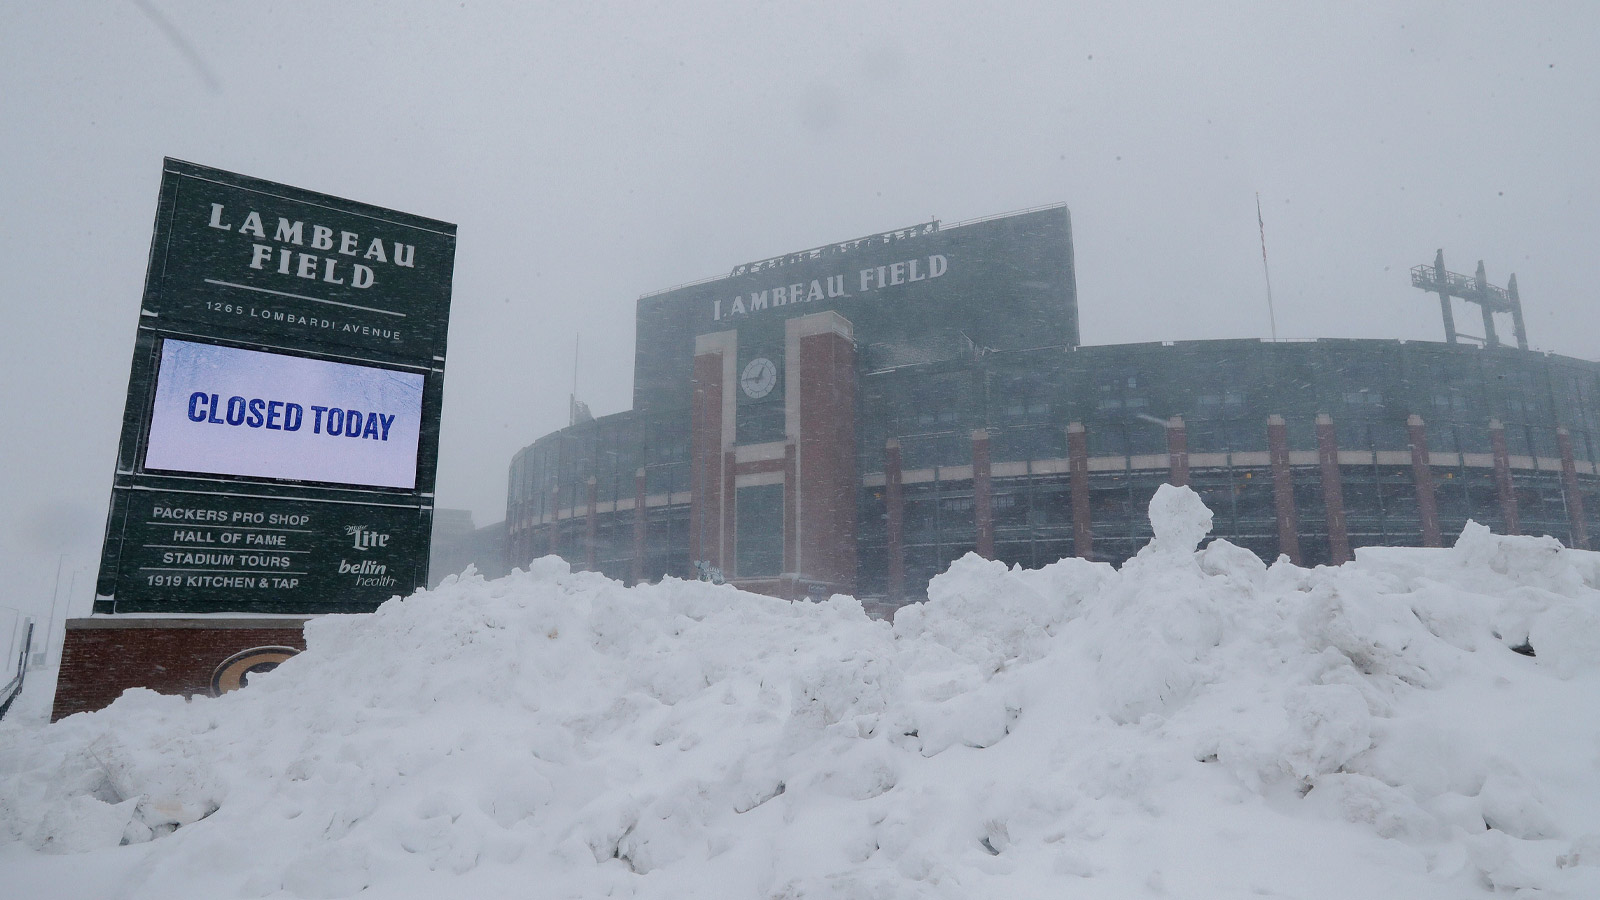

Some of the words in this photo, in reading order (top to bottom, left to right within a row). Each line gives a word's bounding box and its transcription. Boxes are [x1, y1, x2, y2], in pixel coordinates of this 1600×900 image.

[208, 202, 416, 269] LAMBEAU
[249, 243, 375, 289] FIELD
[713, 273, 846, 321] LAMBEAU
[859, 254, 948, 292] FIELD
[206, 301, 243, 315] 1265
[250, 308, 336, 330] LOMBARDI
[342, 323, 401, 340] AVENUE
[187, 391, 304, 432] CLOSED
[310, 405, 396, 442] TODAY
[152, 506, 228, 522] PACKERS
[232, 511, 265, 524] PRO
[268, 513, 310, 526] SHOP
[173, 530, 216, 543] HALL
[220, 532, 242, 545] OF
[246, 534, 287, 546] FAME
[352, 529, 390, 551] Lite
[162, 552, 235, 566] STADIUM
[239, 555, 291, 567] TOURS
[338, 559, 387, 575] bellin
[147, 575, 182, 587] 1919
[186, 576, 255, 589] KITCHEN
[258, 577, 269, 589] &
[271, 578, 299, 589] TAP
[355, 574, 397, 587] health
